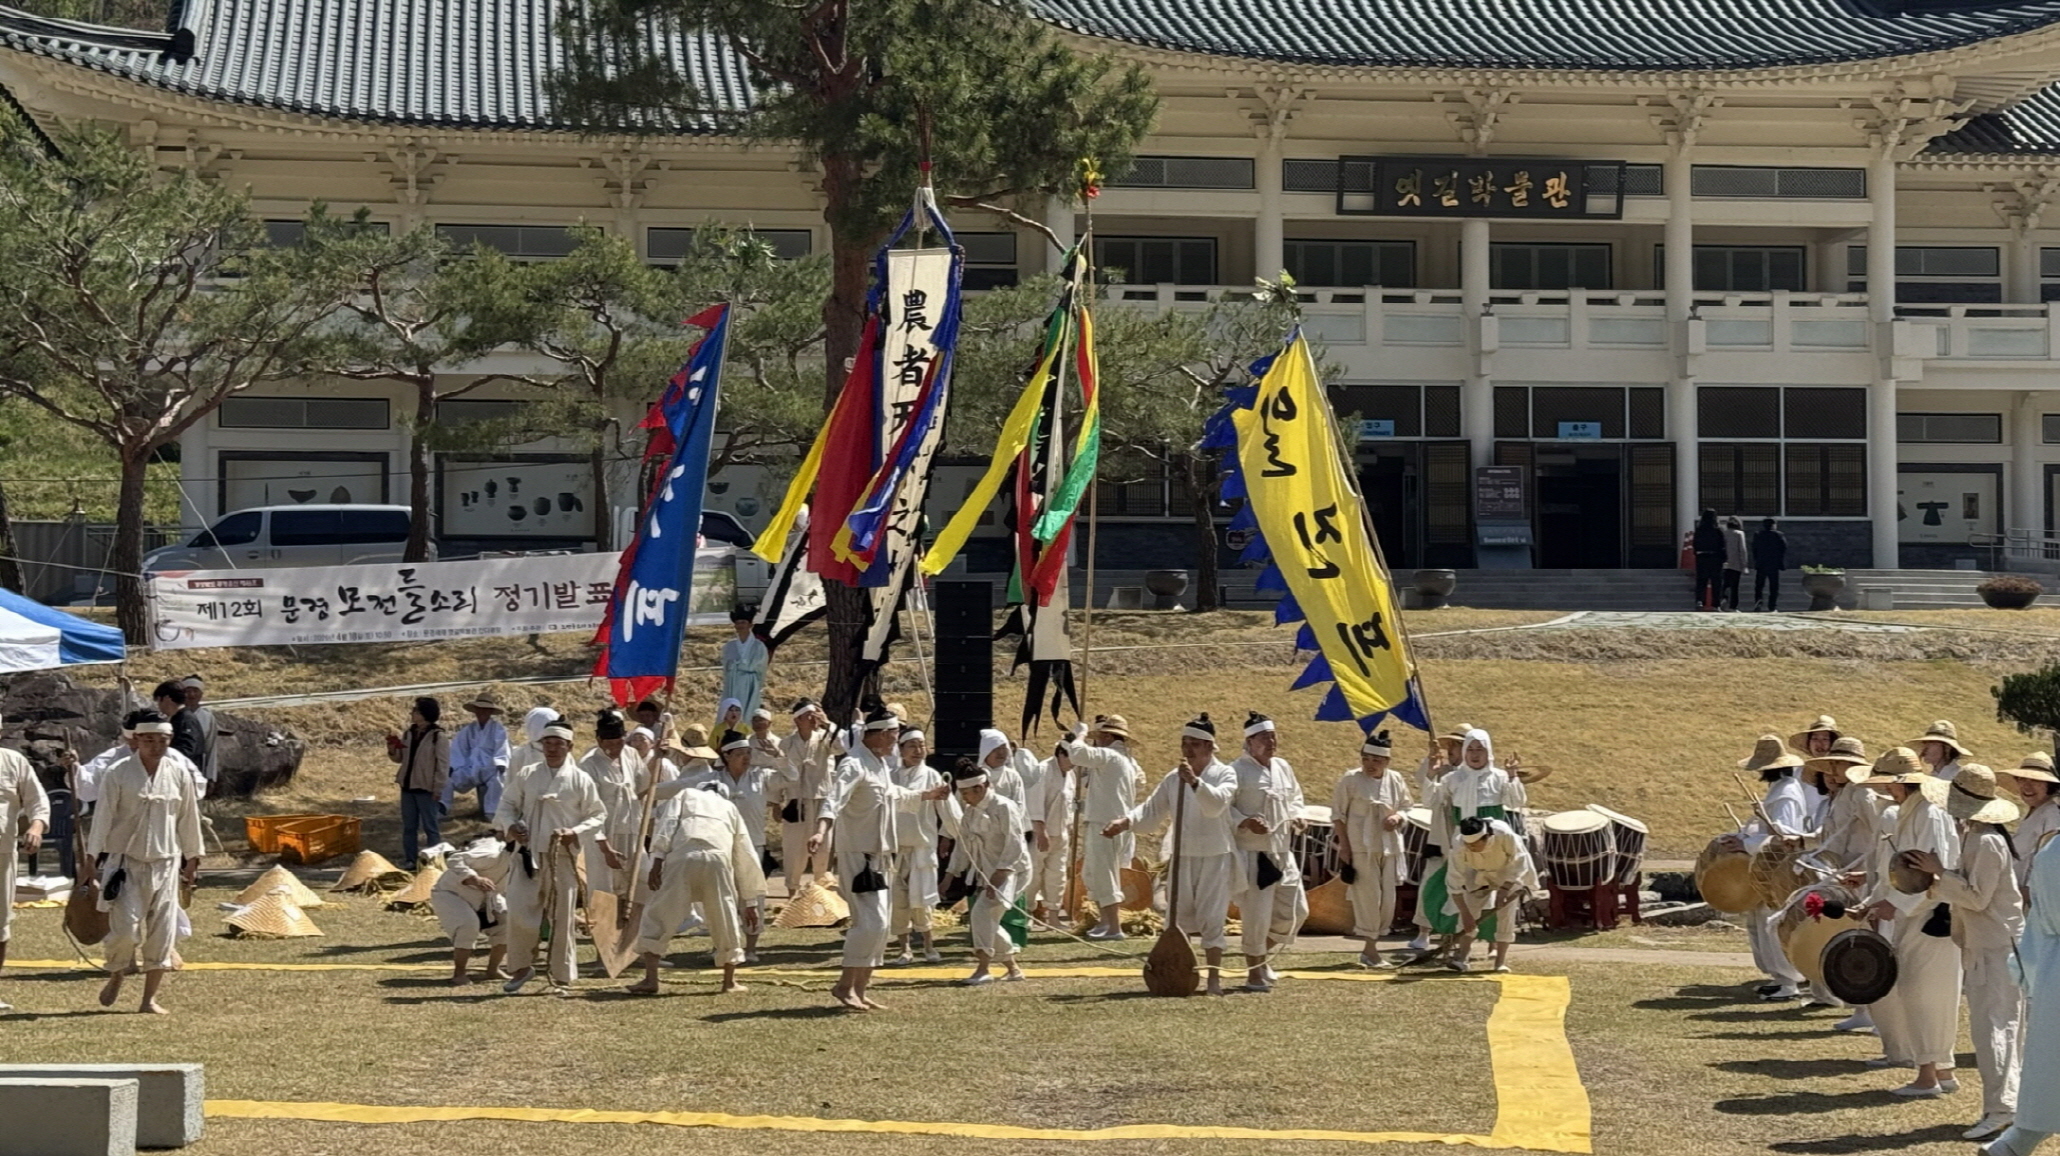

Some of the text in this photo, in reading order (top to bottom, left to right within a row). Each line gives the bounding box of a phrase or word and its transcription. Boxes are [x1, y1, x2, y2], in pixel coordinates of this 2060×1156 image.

[1395, 168, 1572, 208] 옛길박물관
[197, 599, 263, 621] 제12회
[280, 595, 330, 624] 문경
[338, 568, 477, 625] 모전들소리
